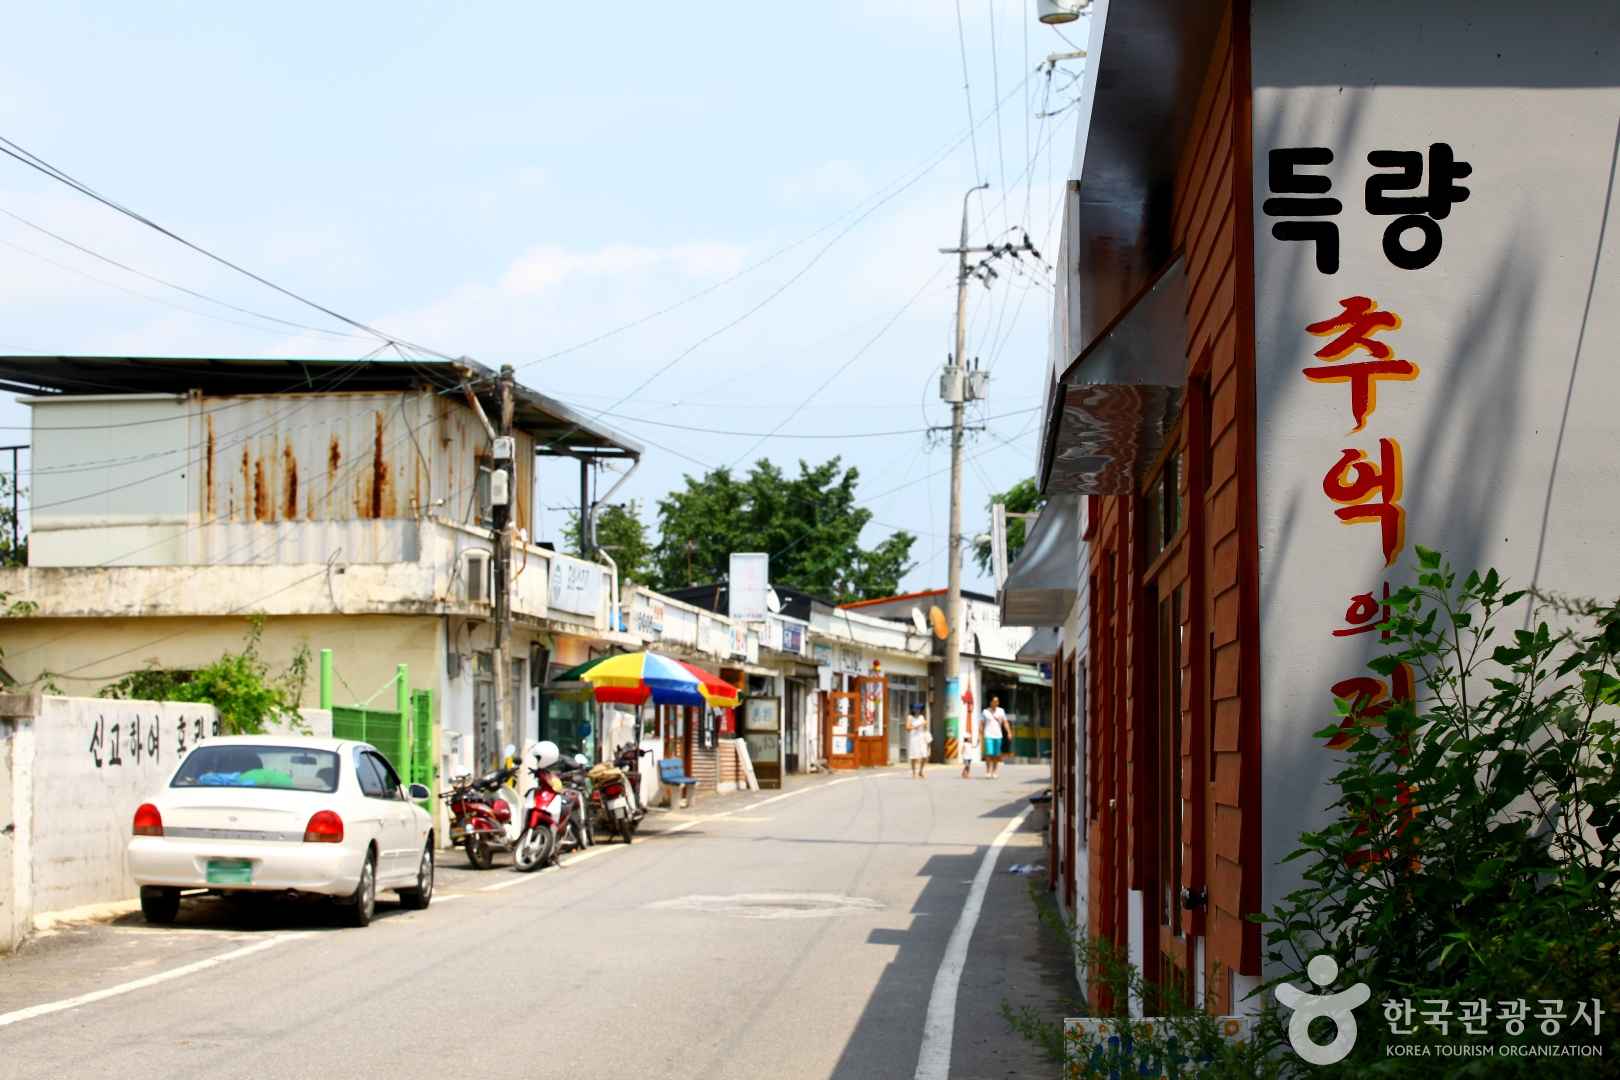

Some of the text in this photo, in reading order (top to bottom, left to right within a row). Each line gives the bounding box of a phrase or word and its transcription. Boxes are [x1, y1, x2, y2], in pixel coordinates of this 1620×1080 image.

[1262, 142, 1472, 275] 득량
[1302, 295, 1421, 640] 추억의
[89, 713, 160, 768] 신고하여
